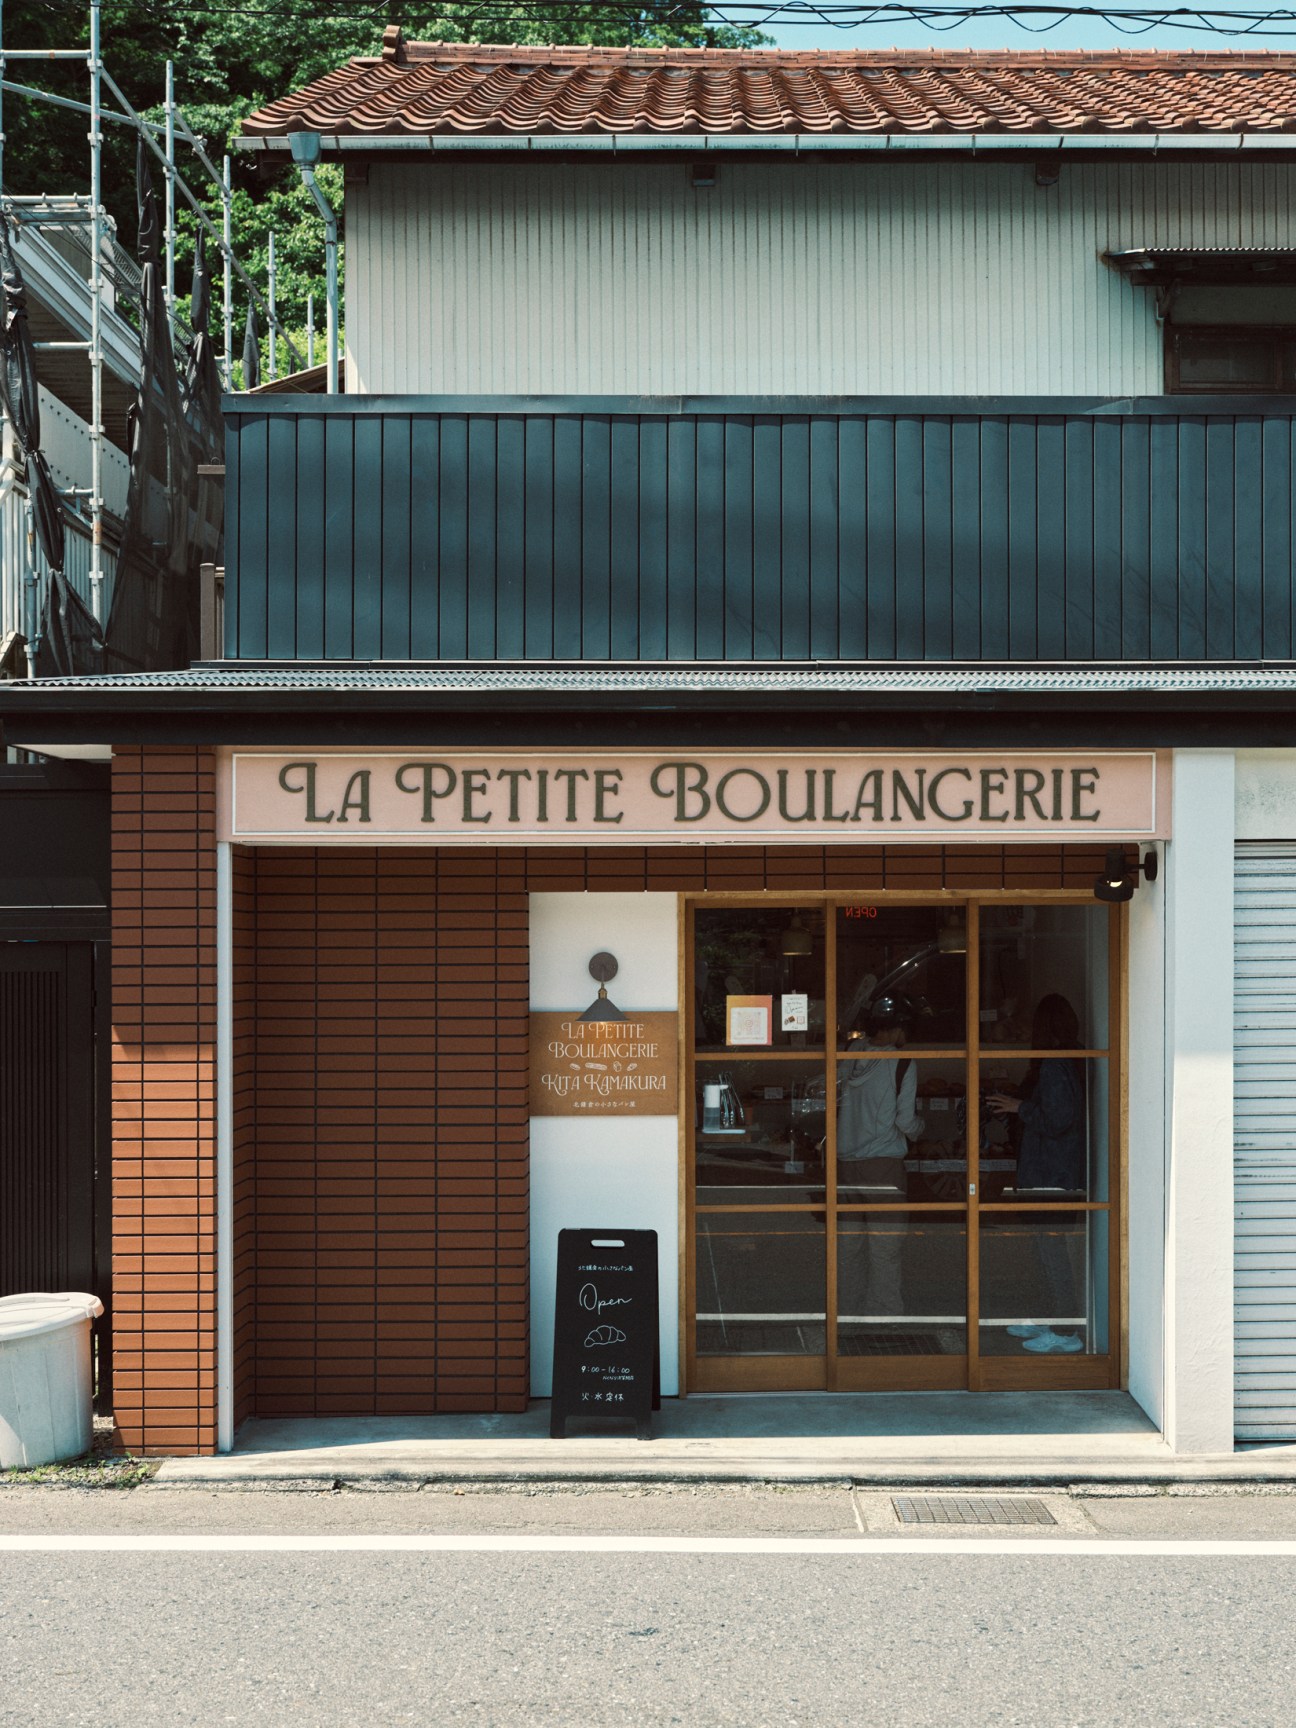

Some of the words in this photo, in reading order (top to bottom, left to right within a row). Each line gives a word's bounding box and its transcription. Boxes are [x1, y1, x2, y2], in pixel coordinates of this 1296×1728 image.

[279, 762, 372, 824] LA
[395, 762, 624, 824] PETITE
[650, 762, 1100, 823] BOULANGERIE
[561, 1022, 585, 1039] LA
[588, 1022, 645, 1039] PETITE
[548, 1041, 659, 1059] BOULANGERIE
[541, 1073, 580, 1096] KITA
[583, 1073, 667, 1096] KAMAKURA
[579, 1283, 633, 1315] Open
